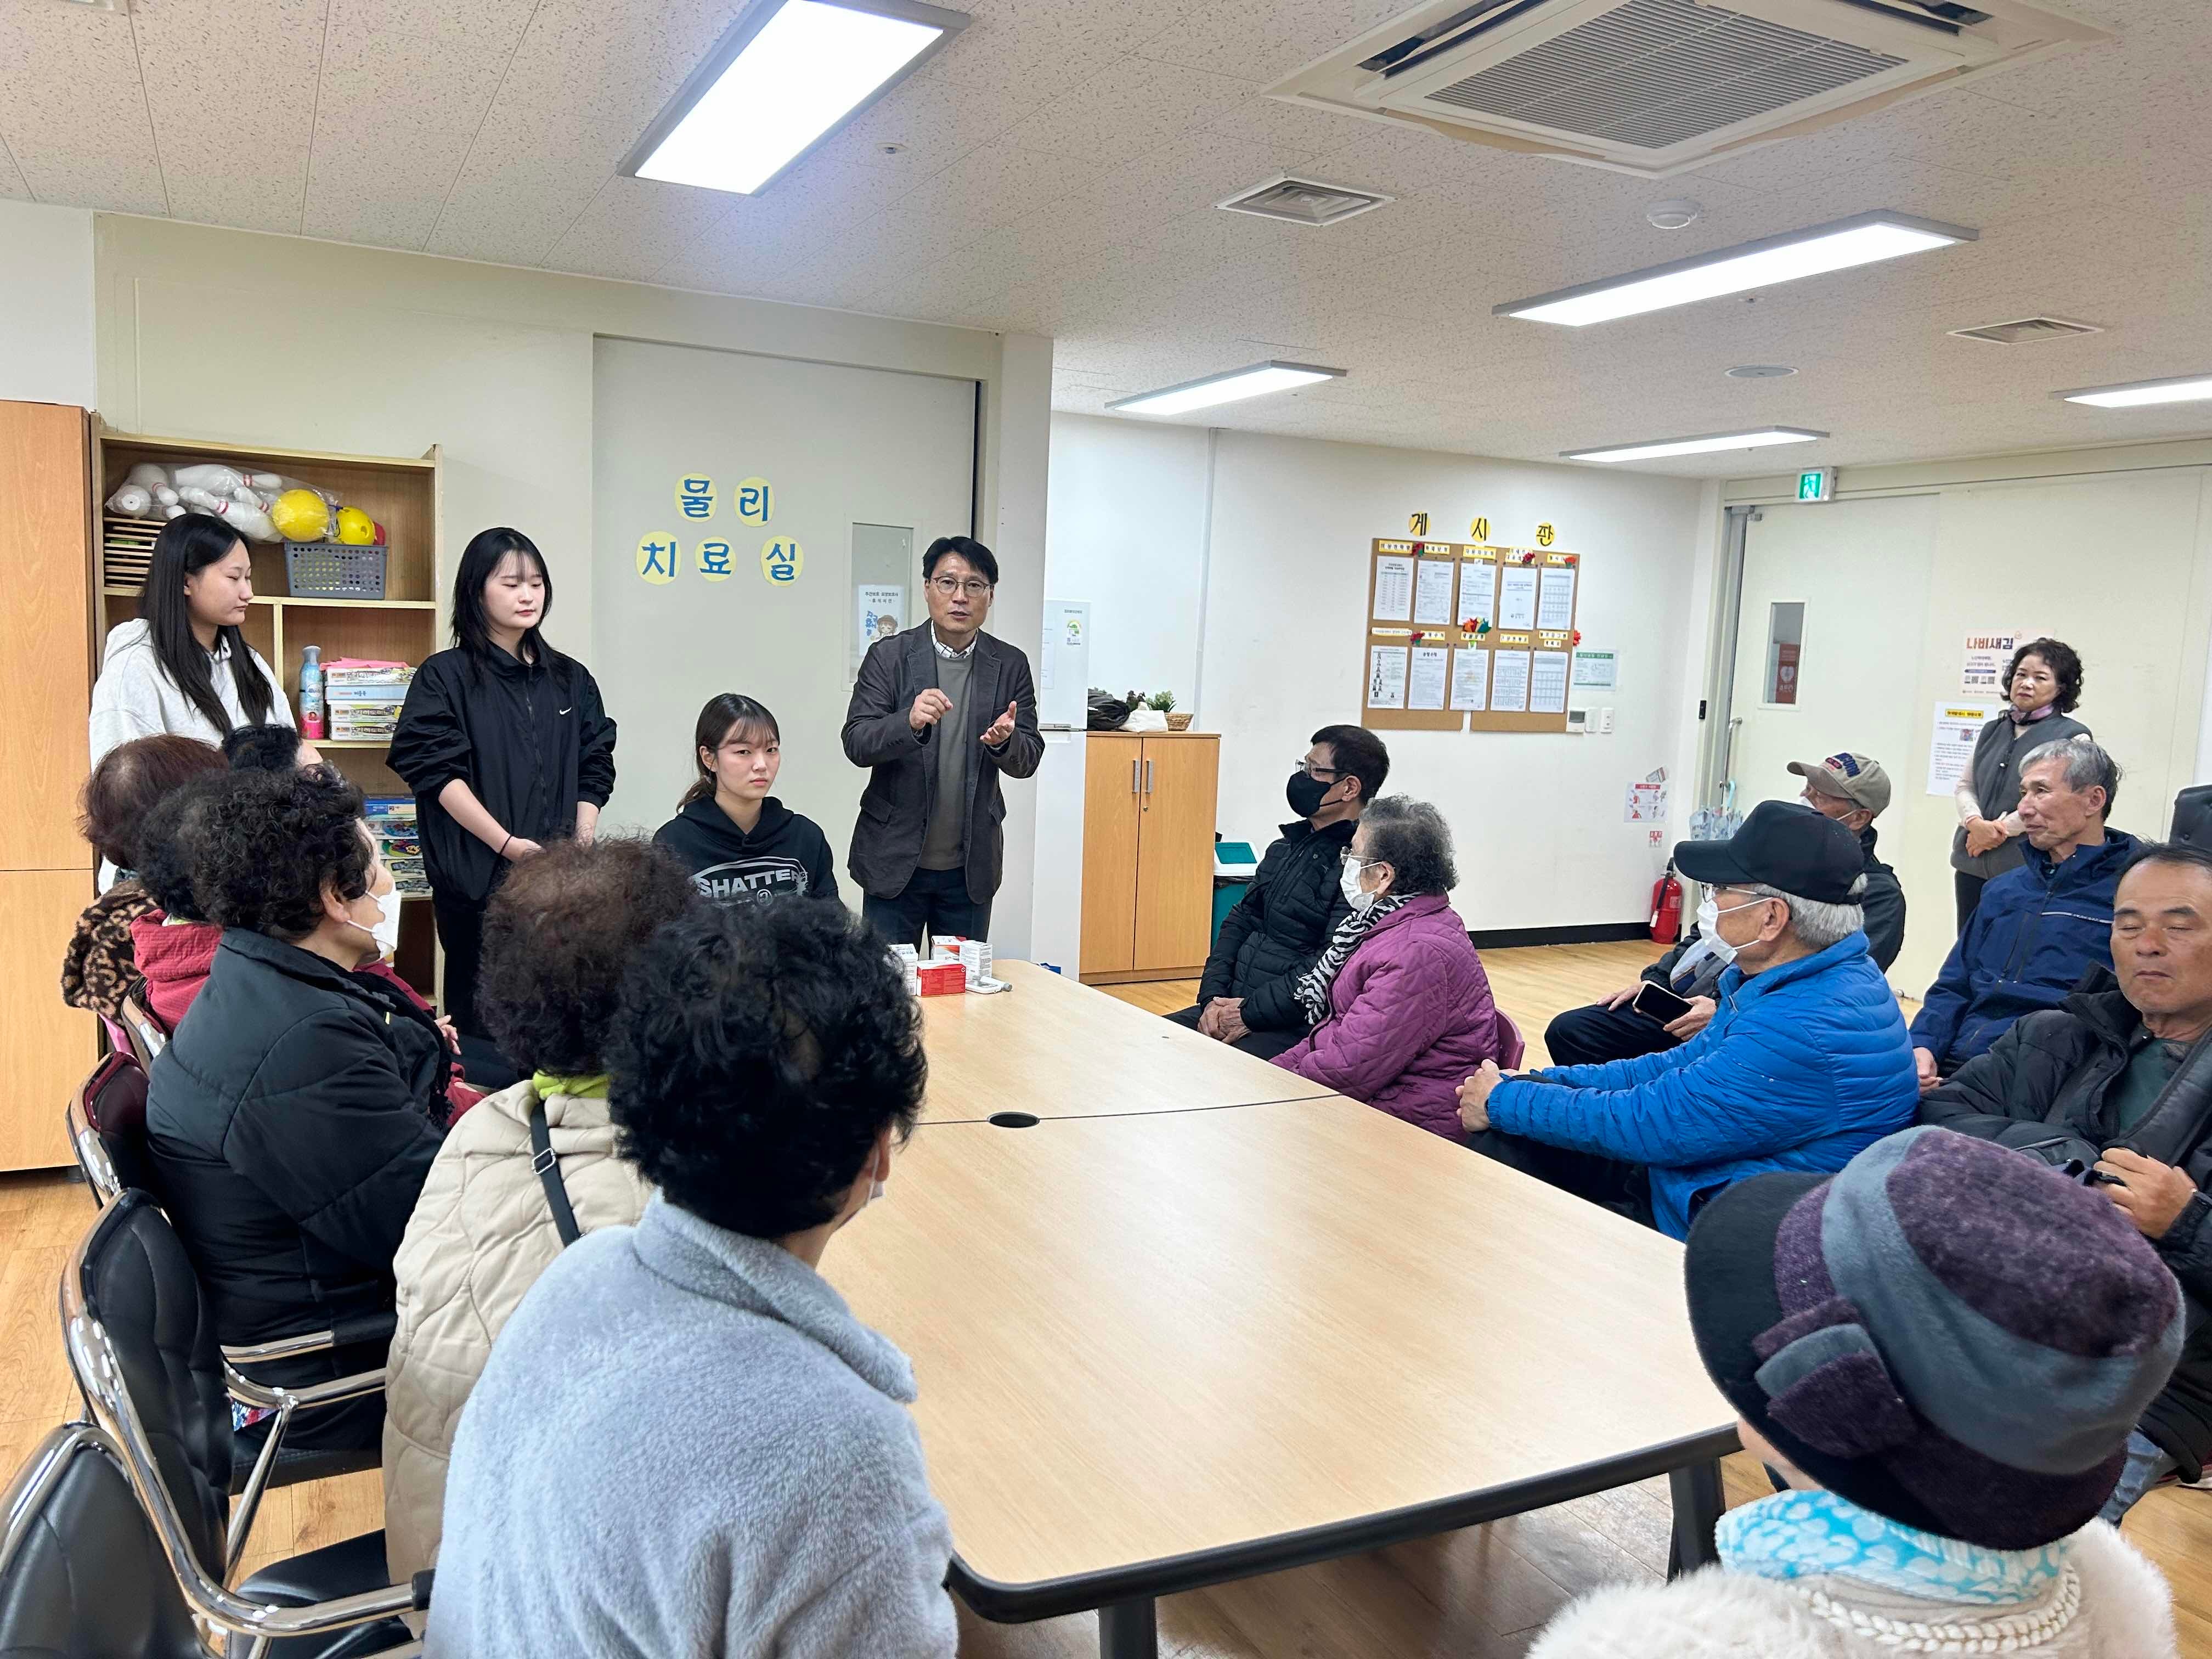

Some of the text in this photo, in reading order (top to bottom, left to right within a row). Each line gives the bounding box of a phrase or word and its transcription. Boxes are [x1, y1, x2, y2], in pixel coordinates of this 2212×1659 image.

[680, 478, 769, 522] 물리
[1410, 513, 1554, 547] 게시판
[641, 541, 796, 581] 치료실
[1966, 637, 2013, 650] 나비새김
